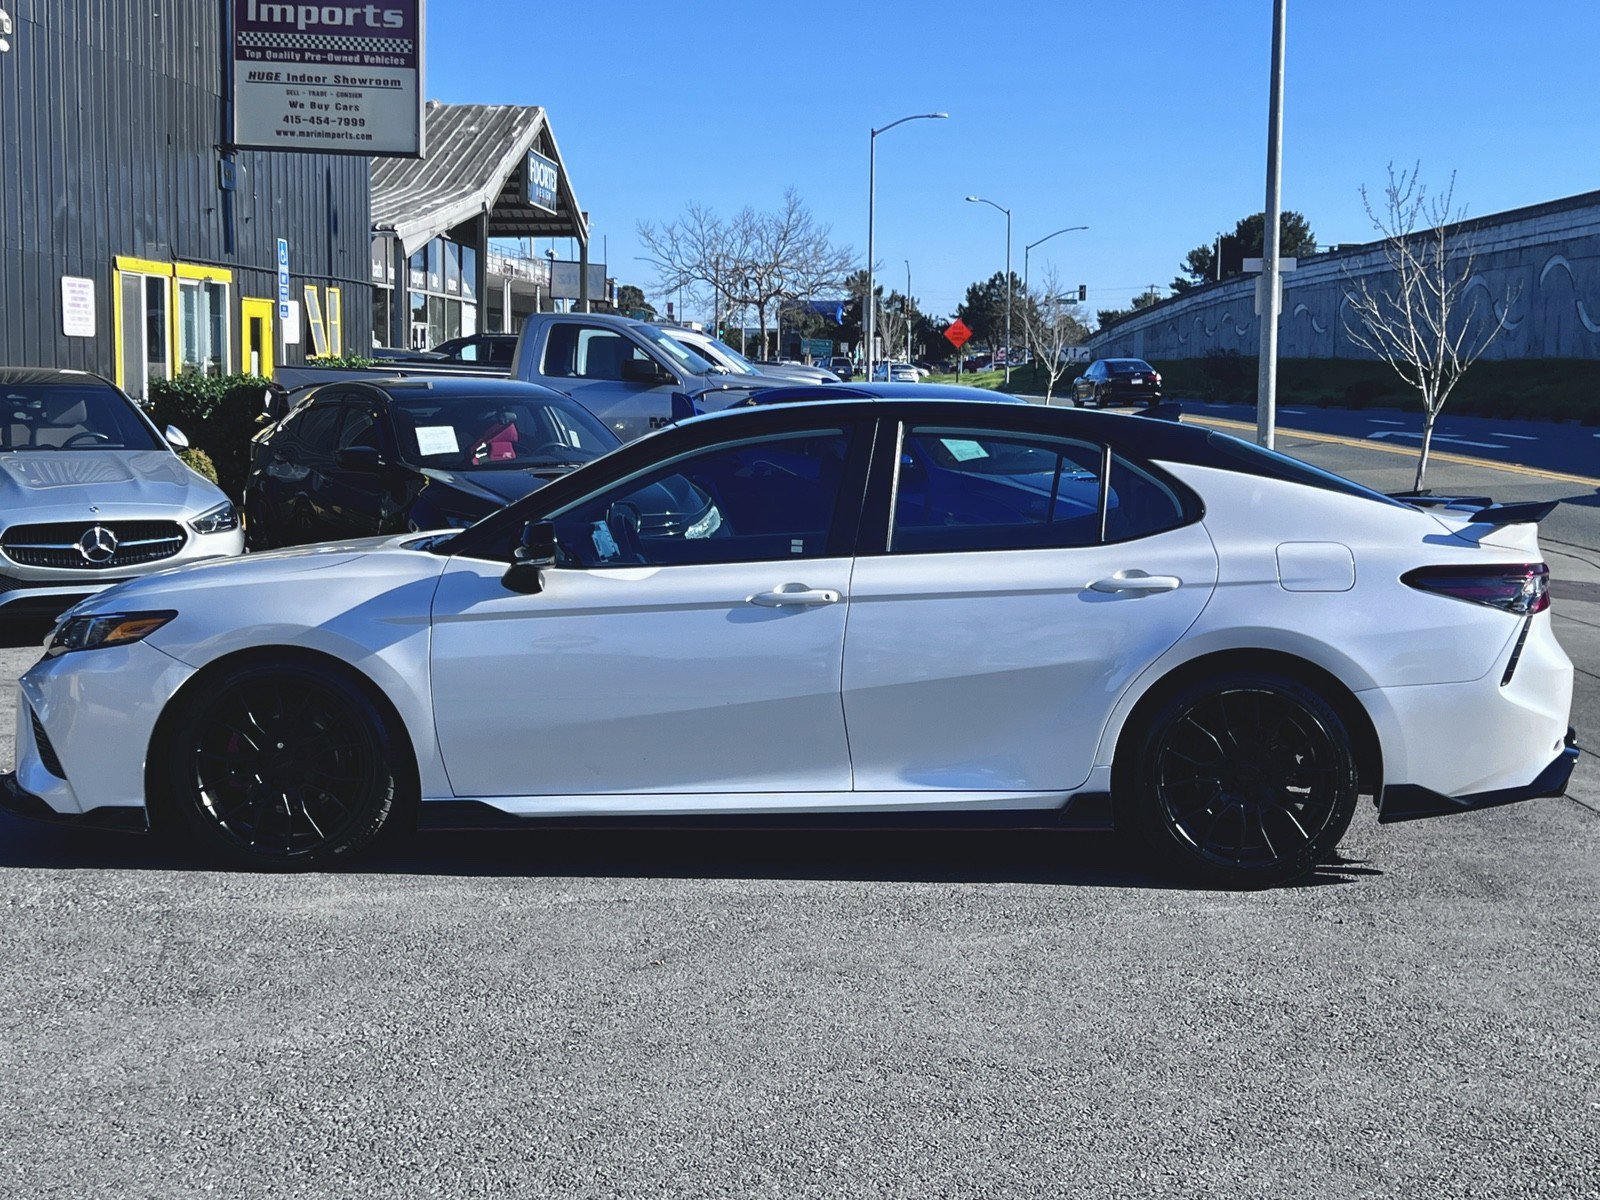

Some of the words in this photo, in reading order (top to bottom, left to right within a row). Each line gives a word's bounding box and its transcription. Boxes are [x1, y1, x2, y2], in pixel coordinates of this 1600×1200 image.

[247, 0, 404, 31] Imports
[245, 49, 262, 59] Top
[265, 50, 301, 62] Quality
[304, 52, 360, 64] Pre-Owned
[364, 53, 406, 66] Vehicles
[248, 71, 282, 82] HUGE
[286, 72, 328, 84] Indoor
[334, 75, 402, 87] Showroom
[288, 100, 305, 110] We
[310, 101, 330, 112] Buy
[335, 102, 360, 112] Cars
[282, 115, 366, 128] 415-454-7999
[275, 129, 373, 141] www.marinimports.com
